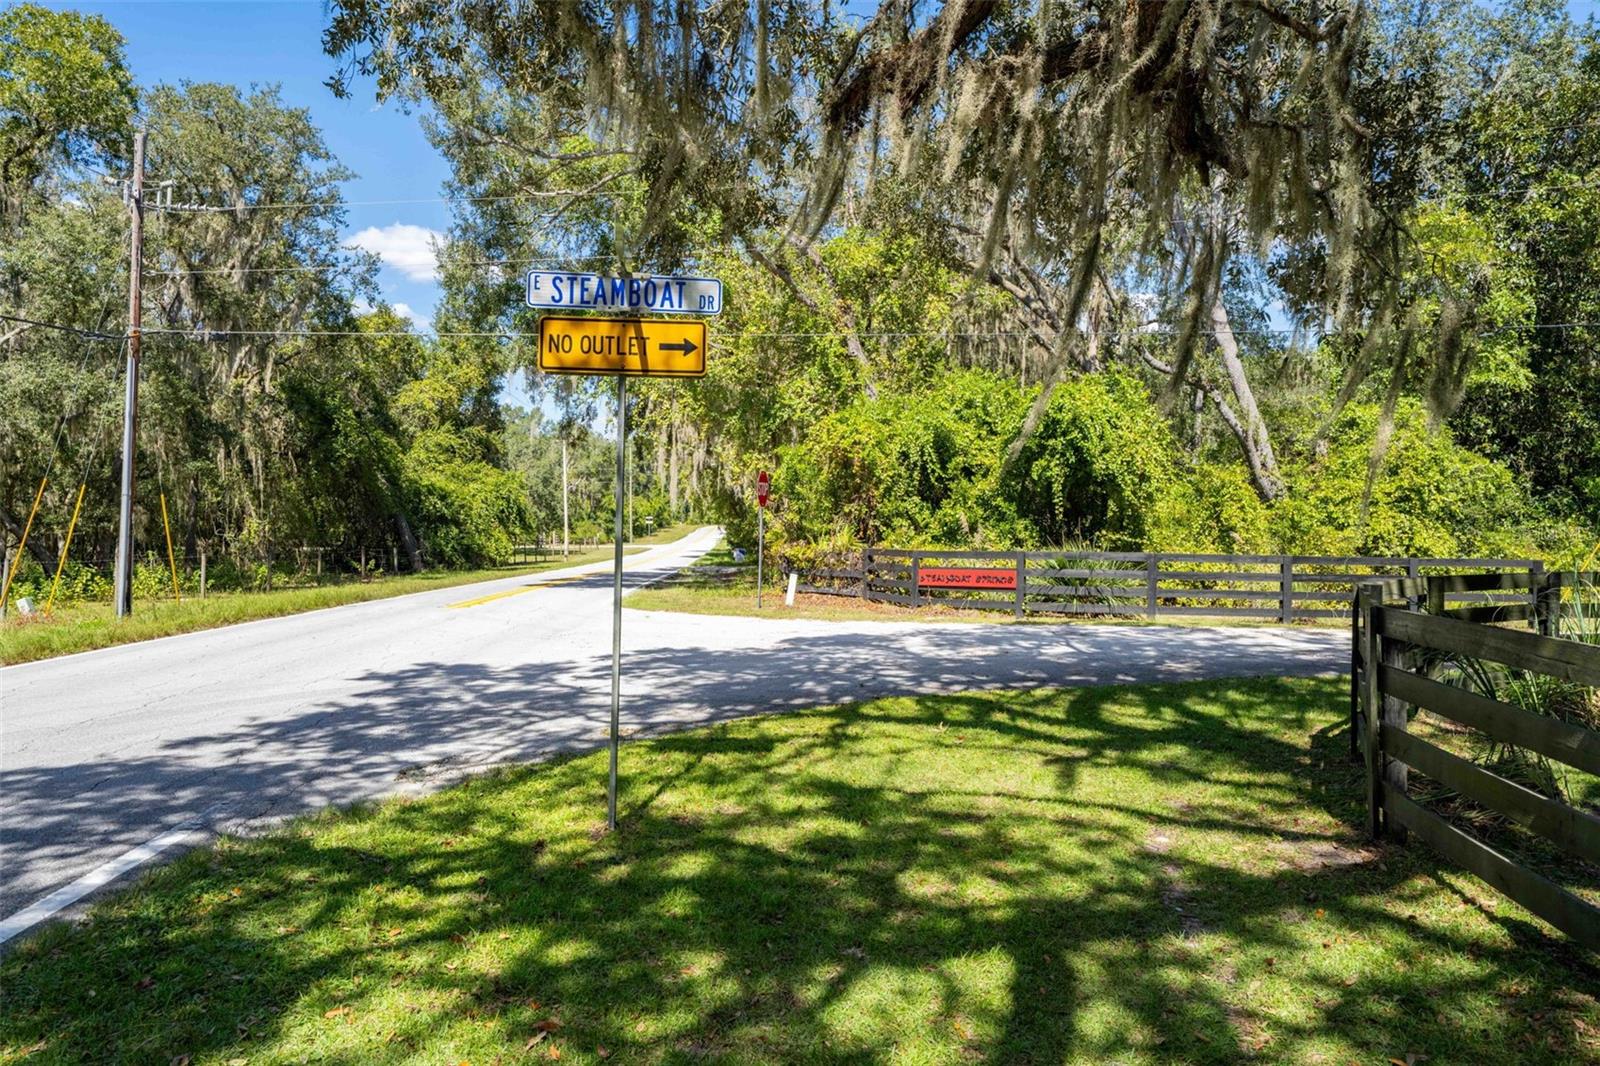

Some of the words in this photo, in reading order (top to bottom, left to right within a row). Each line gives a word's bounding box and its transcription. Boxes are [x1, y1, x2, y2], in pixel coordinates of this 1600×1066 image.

[534, 275, 541, 290] E
[551, 276, 686, 309] STEAMBOAT
[699, 295, 715, 310] DR
[548, 334, 573, 353] NO
[580, 334, 650, 356] OUTLET
[758, 482, 768, 495] STOP
